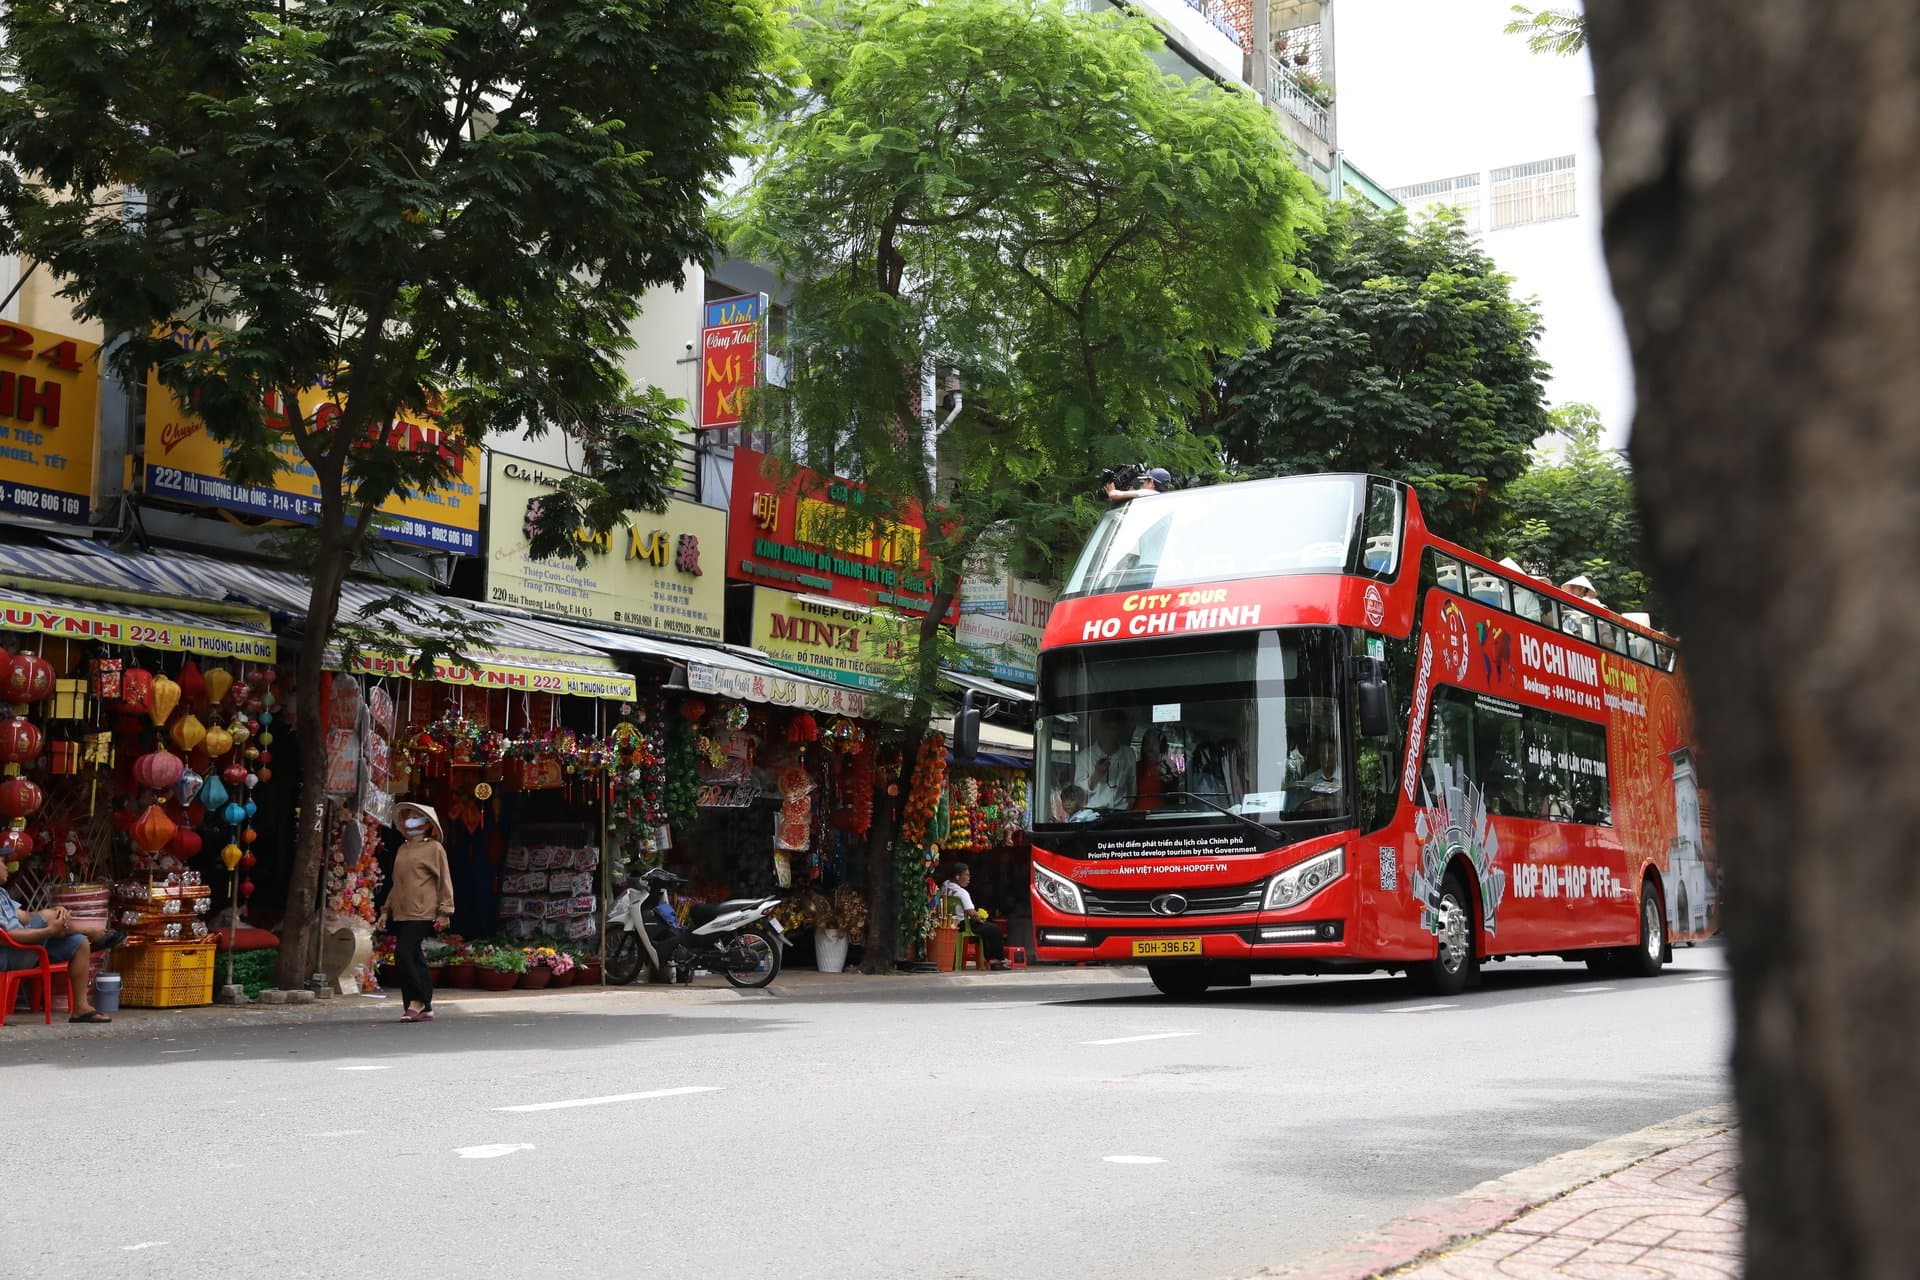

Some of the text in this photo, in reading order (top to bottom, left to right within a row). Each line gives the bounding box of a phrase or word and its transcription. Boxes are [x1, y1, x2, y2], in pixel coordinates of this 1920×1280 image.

[707, 332, 730, 349] Công
[706, 354, 741, 387] Mi
[14, 428, 43, 446] TIỆC
[155, 466, 182, 491] 222
[200, 480, 231, 501] THƯỢNG
[273, 495, 289, 511] P.14
[15, 488, 39, 507] 0902
[41, 494, 60, 511] 606
[63, 499, 80, 515] 169
[753, 491, 780, 533] 明
[448, 529, 460, 545] 606
[461, 532, 473, 548] 169
[626, 523, 671, 569] Mi
[755, 538, 781, 559] KINH
[783, 544, 816, 568] DOANH
[833, 556, 863, 579] TRANG
[492, 587, 507, 602] 220
[523, 579, 542, 593] Trang
[1122, 588, 1228, 612] CITY TOUR
[769, 612, 861, 654] MINH
[1082, 604, 1262, 641] HO CHI MINH
[130, 624, 172, 646] 224
[179, 630, 196, 648] HẢI
[198, 635, 233, 655] THƯỢNG
[254, 640, 272, 657] ÔNG
[810, 653, 833, 667] TRANG
[849, 659, 864, 674] TIỆC
[1519, 633, 1541, 669] HO
[1542, 641, 1566, 678] CHI
[1566, 649, 1599, 688] MINH
[533, 674, 562, 690] 222
[580, 680, 605, 696] THƯỢNG
[770, 678, 831, 709] Mi Mi
[1552, 686, 1564, 702] +84
[1564, 688, 1576, 705] 913
[1580, 757, 1592, 775] CITY
[315, 803, 324, 817] 5
[1088, 852, 1110, 861] Priority
[1110, 850, 1132, 860] Project
[1141, 849, 1166, 859] develop
[1167, 848, 1192, 857] tourism
[1193, 847, 1202, 857] by
[1202, 847, 1214, 855] the
[1214, 845, 1257, 855] Government
[1108, 841, 1115, 849] án
[1125, 839, 1141, 848] điểm
[1142, 839, 1157, 850] phát
[1157, 838, 1173, 847] triển
[1184, 839, 1195, 848] lịch
[1196, 837, 1208, 845] của
[1209, 837, 1229, 845] Chính
[1230, 835, 1243, 846] phủ
[1136, 865, 1152, 876] VIỆT
[1153, 864, 1214, 874] HOPON-HOPOFF
[1216, 863, 1228, 873] VN
[1512, 863, 1537, 898] HOP
[1137, 940, 1197, 955] 50H-396.62
